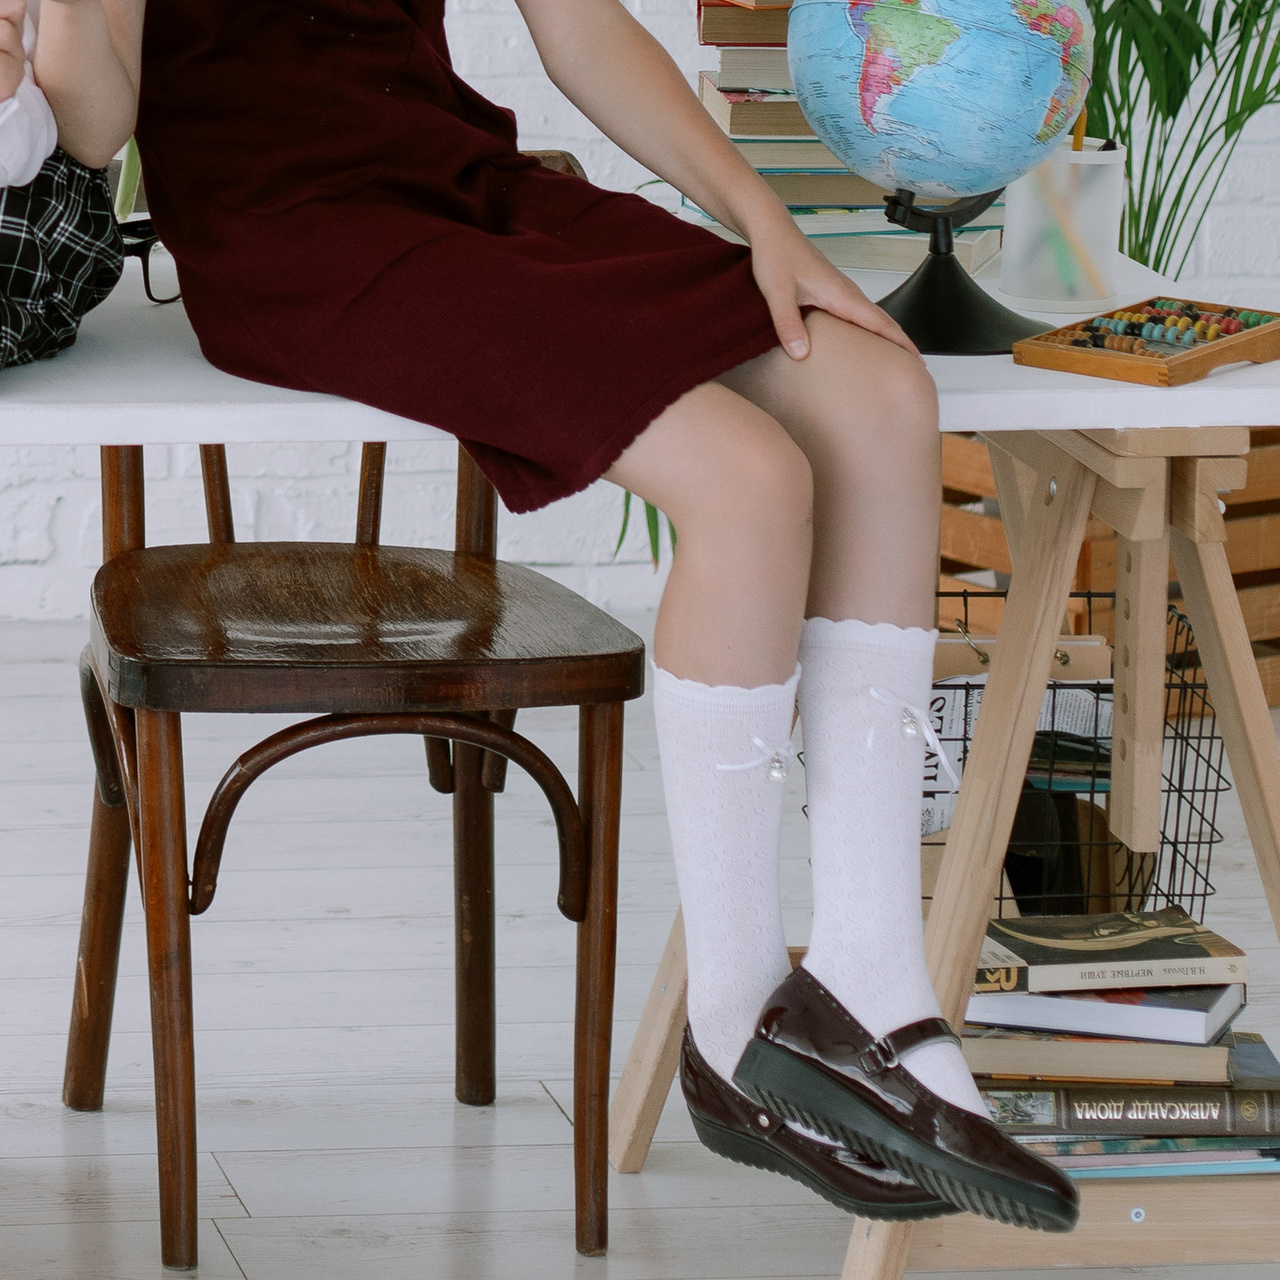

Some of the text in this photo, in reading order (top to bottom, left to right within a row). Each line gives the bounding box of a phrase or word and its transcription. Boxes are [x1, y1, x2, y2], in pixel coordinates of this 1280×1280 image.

[1080, 970, 1108, 980] ДУШИ
[1110, 968, 1154, 979] МЕРТВЫЕ
[1073, 1099, 1125, 1121] ДЮМА
[1127, 1099, 1220, 1121] АЛЕКСАНДР
